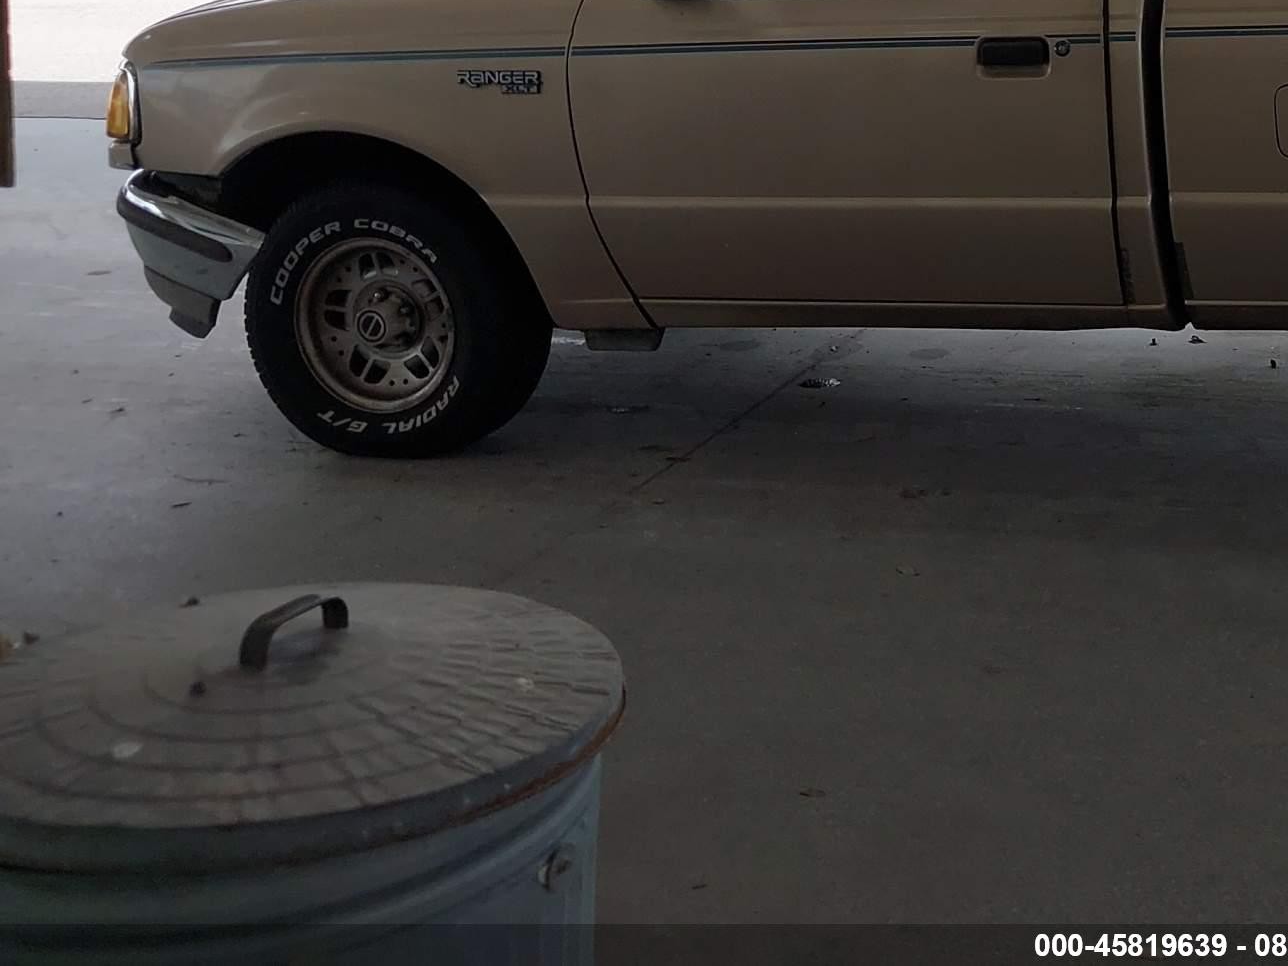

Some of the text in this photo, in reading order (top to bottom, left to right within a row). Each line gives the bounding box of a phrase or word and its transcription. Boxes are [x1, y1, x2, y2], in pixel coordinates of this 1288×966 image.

[269, 218, 438, 306] COOPER COBRA
[316, 374, 461, 435] RADIAL G/T
